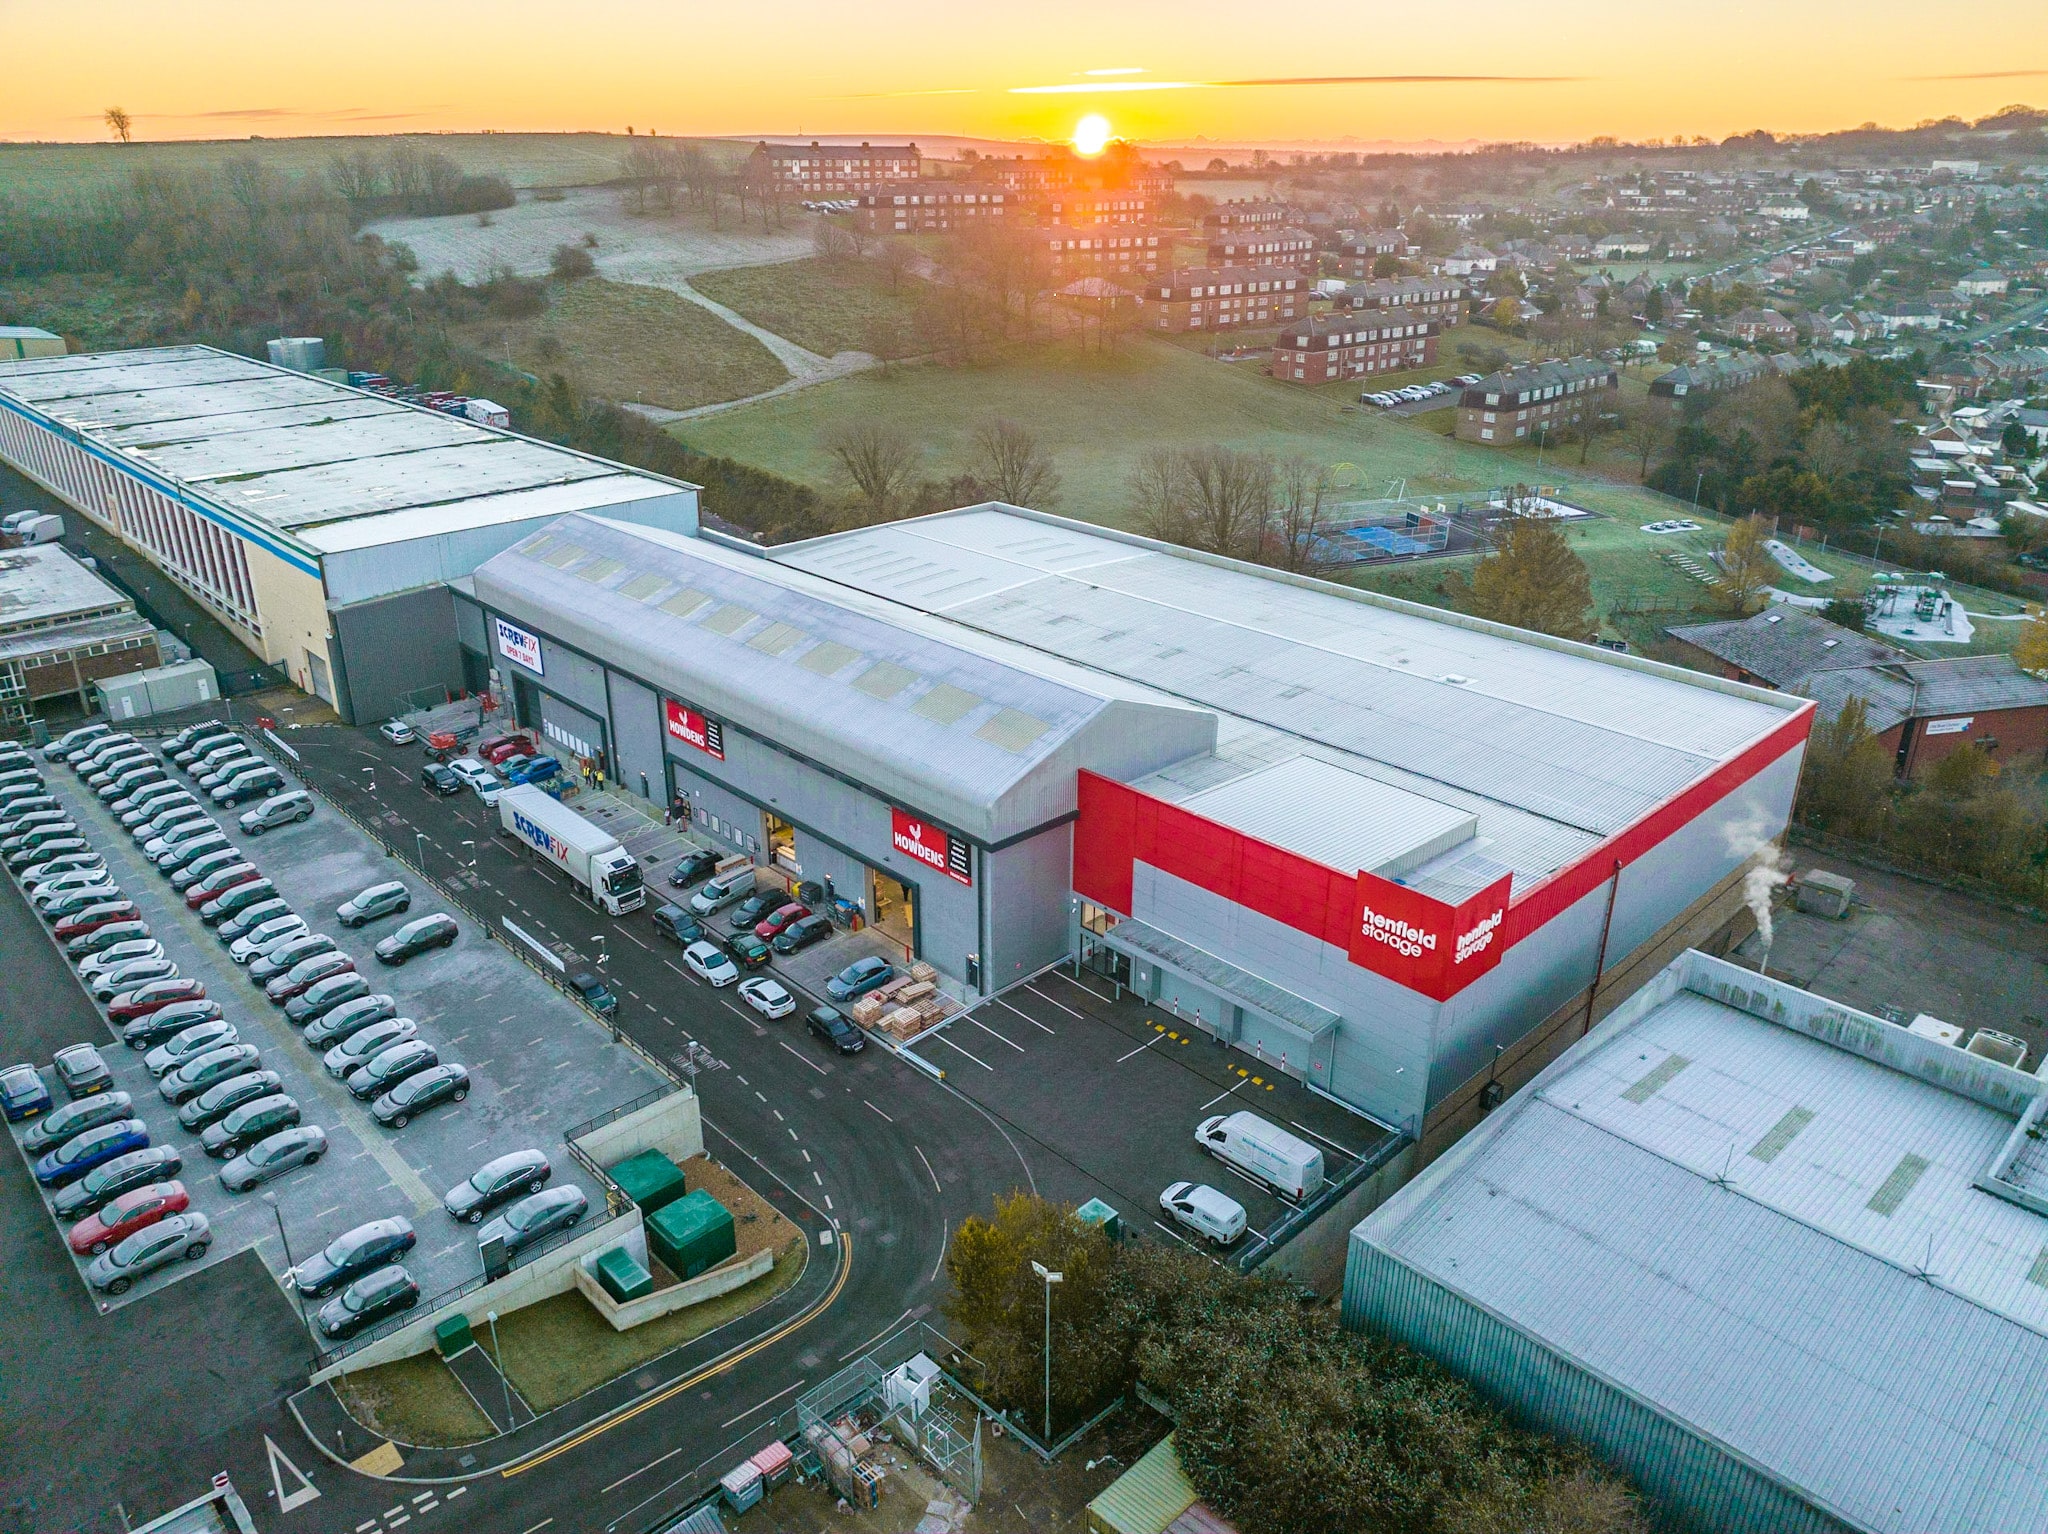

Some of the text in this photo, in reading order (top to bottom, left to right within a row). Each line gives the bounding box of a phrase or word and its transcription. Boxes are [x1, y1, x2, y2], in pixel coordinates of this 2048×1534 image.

[498, 623, 537, 654] SCREWFIX
[669, 719, 705, 747] HOWDENS
[513, 811, 569, 865] SCREWFIX
[894, 831, 945, 868] HOWDENS
[1361, 923, 1422, 958] storage
[1362, 905, 1437, 951] henfield
[1456, 908, 1503, 952] henfield
[1454, 931, 1494, 965] storage
